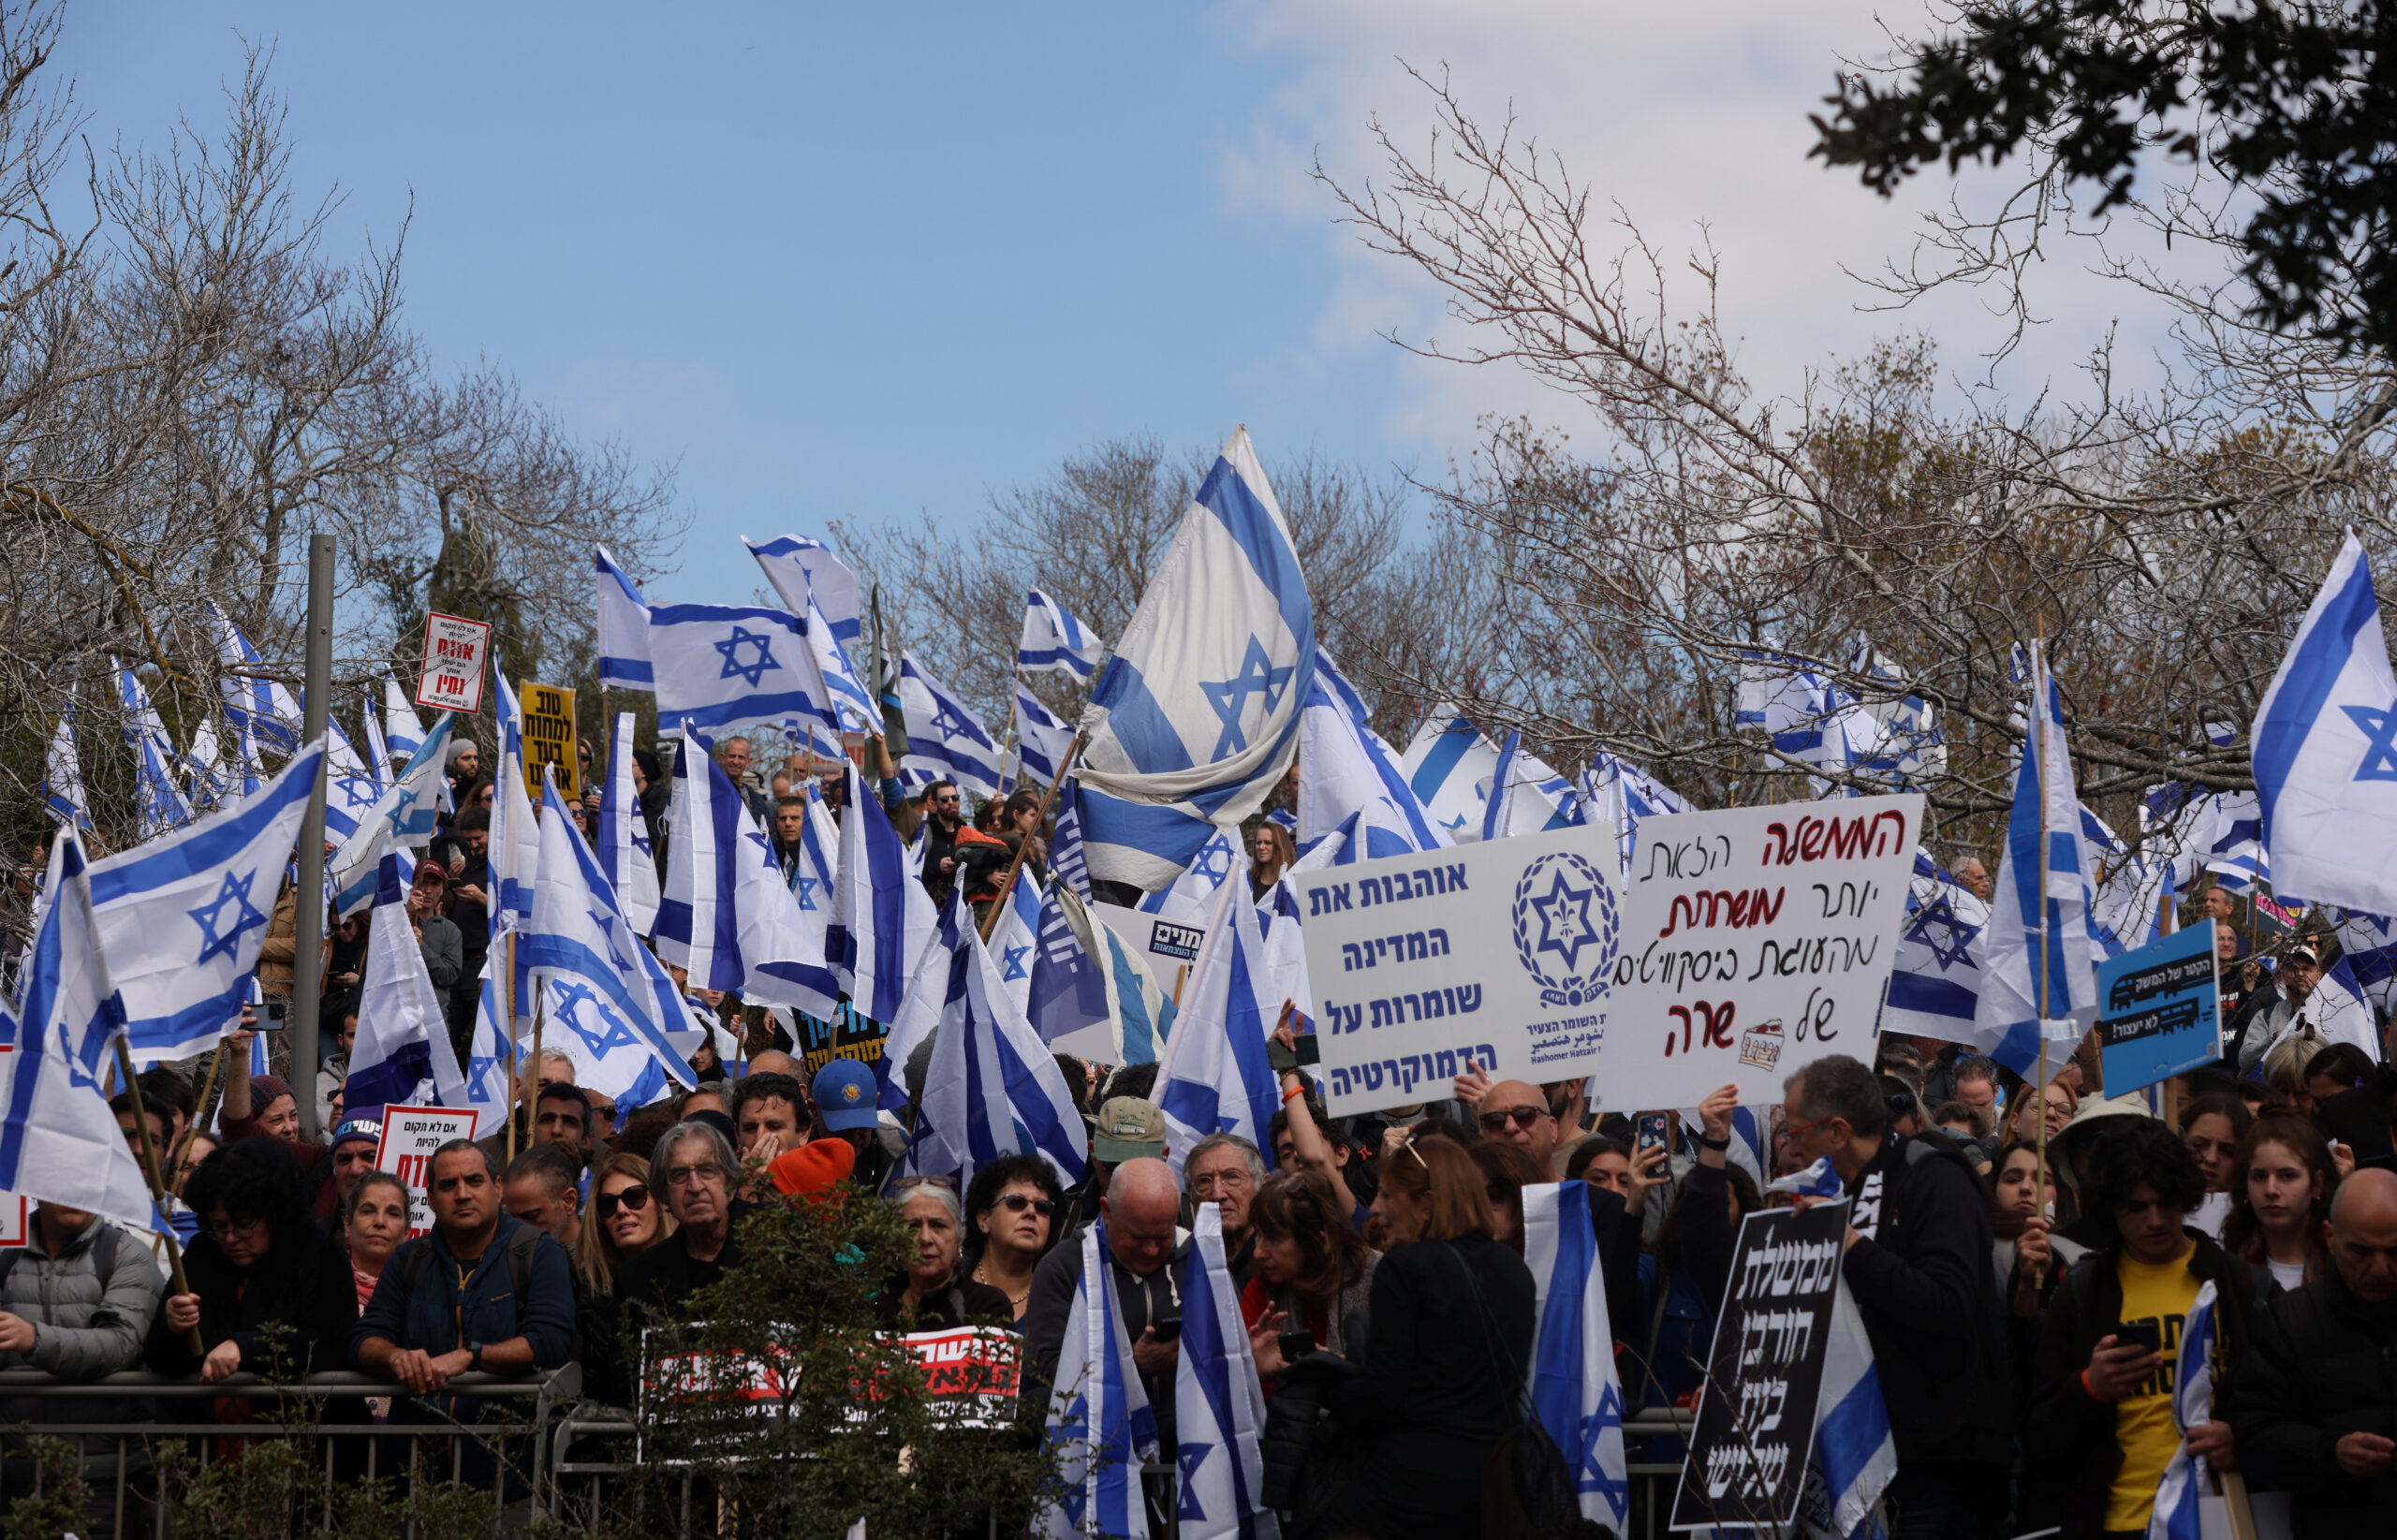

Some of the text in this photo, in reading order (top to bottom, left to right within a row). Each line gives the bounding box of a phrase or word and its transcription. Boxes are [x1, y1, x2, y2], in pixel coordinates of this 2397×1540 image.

[435, 674, 465, 696] נתין
[536, 691, 561, 716] טוב
[525, 713, 571, 742] למחות
[534, 740, 564, 766] בעד
[528, 763, 571, 791] ארנו
[1640, 809, 1905, 883] הממשלה הזאת
[1308, 862, 1469, 917] אוהבות את
[1659, 880, 1878, 938] יותר מושחתת
[1154, 942, 1191, 958] העצמאות
[1155, 924, 1201, 949] מנים
[1342, 928, 1450, 972] המדינה
[1611, 934, 1878, 993] מהעוגת ביסקוויטים
[2135, 959, 2211, 993] הקטר של המשק
[1325, 982, 1482, 1035] שומרות על
[1561, 1015, 1597, 1031] השומר
[1664, 986, 1838, 1058] של שרה
[2144, 1014, 2159, 1029] לא
[1526, 1020, 1559, 1035] הצעיר
[1331, 1043, 1498, 1097] הדמוקרטיה
[1531, 1051, 1568, 1063] Hashomer
[1569, 1047, 1596, 1058] Hatzair
[404, 1121, 458, 1135] אם לא תקום
[415, 1137, 441, 1148] להיות
[1736, 1224, 1839, 1300] ממשלת
[1734, 1307, 1815, 1386] חורבן
[1731, 1375, 1788, 1432] בית
[1706, 1423, 1789, 1498] שלישי
